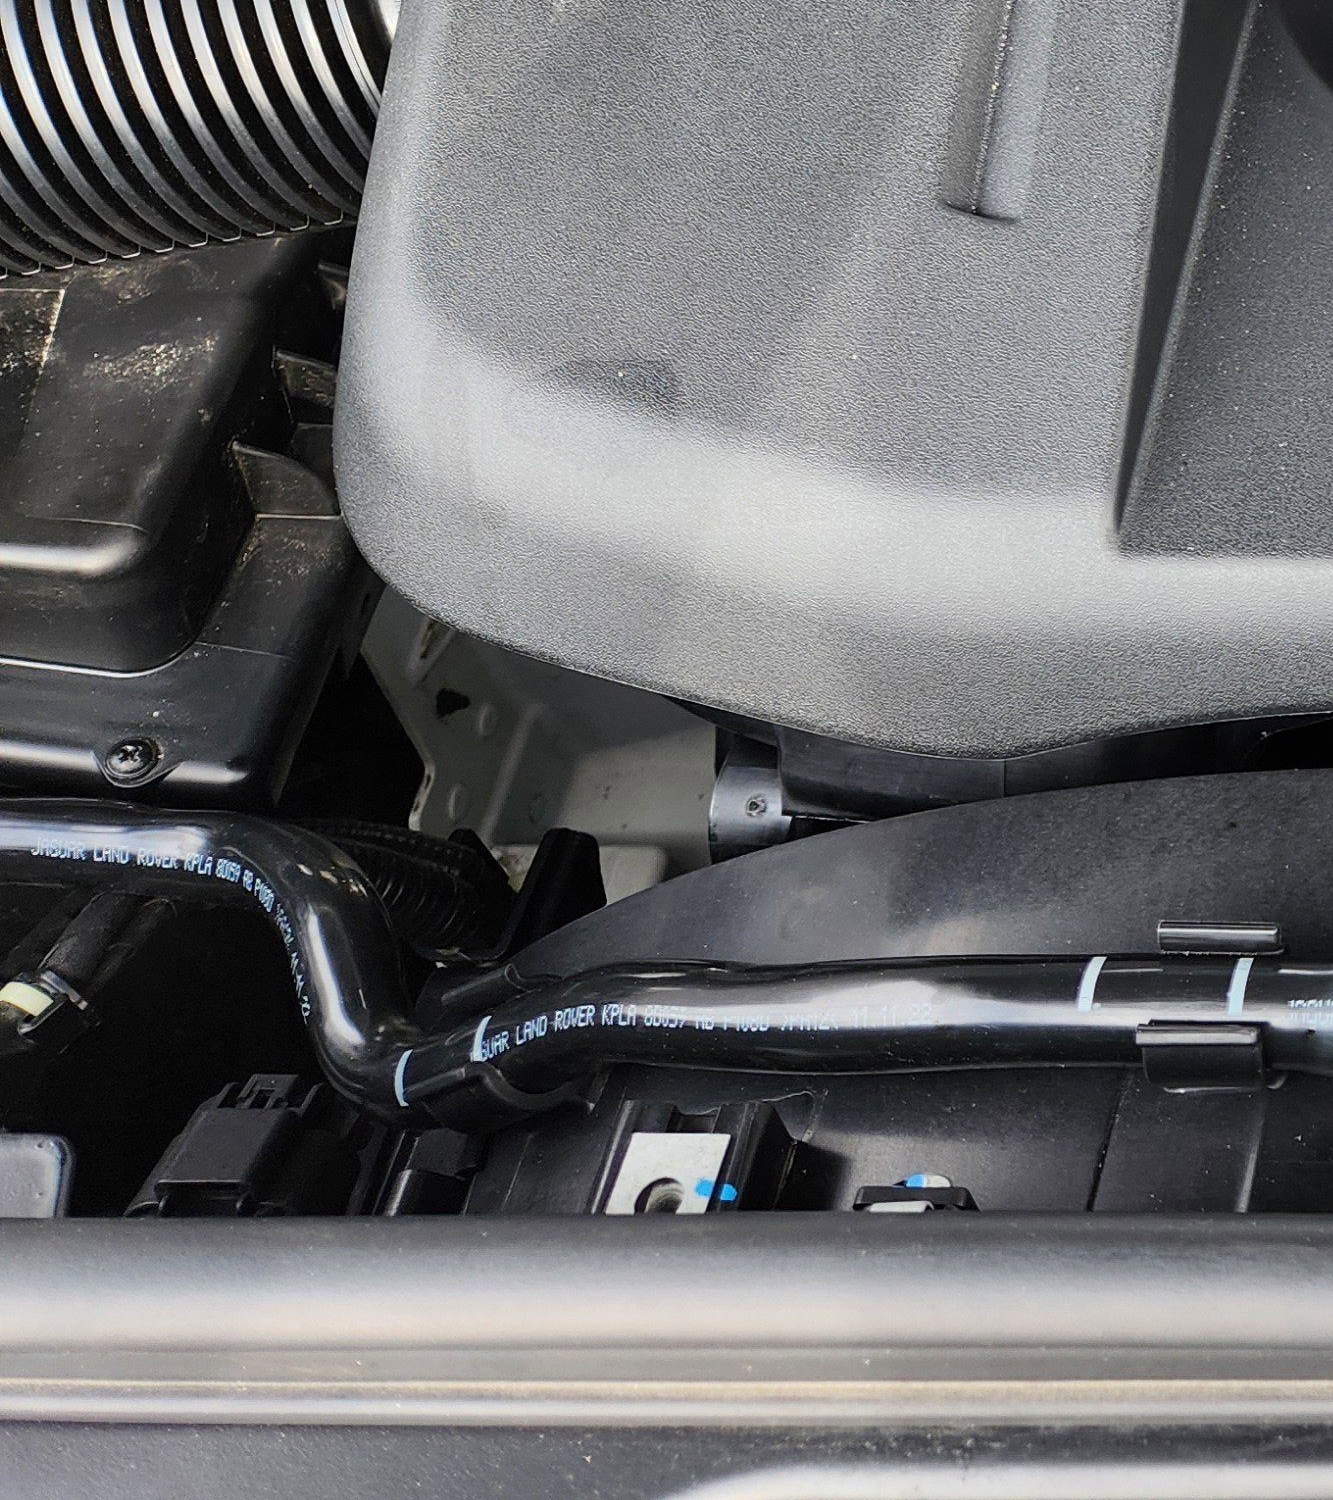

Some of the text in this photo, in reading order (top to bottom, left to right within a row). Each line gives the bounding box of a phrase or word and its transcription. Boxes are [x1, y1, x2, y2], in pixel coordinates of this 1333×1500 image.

[30, 837, 87, 860] JAGUAR
[92, 845, 130, 865] LAND
[136, 848, 179, 870] ROVER
[468, 1030, 511, 1064] GUAR
[515, 1014, 549, 1046] LAND
[554, 1003, 596, 1033] ROVER
[601, 1003, 638, 1027] KPLA
